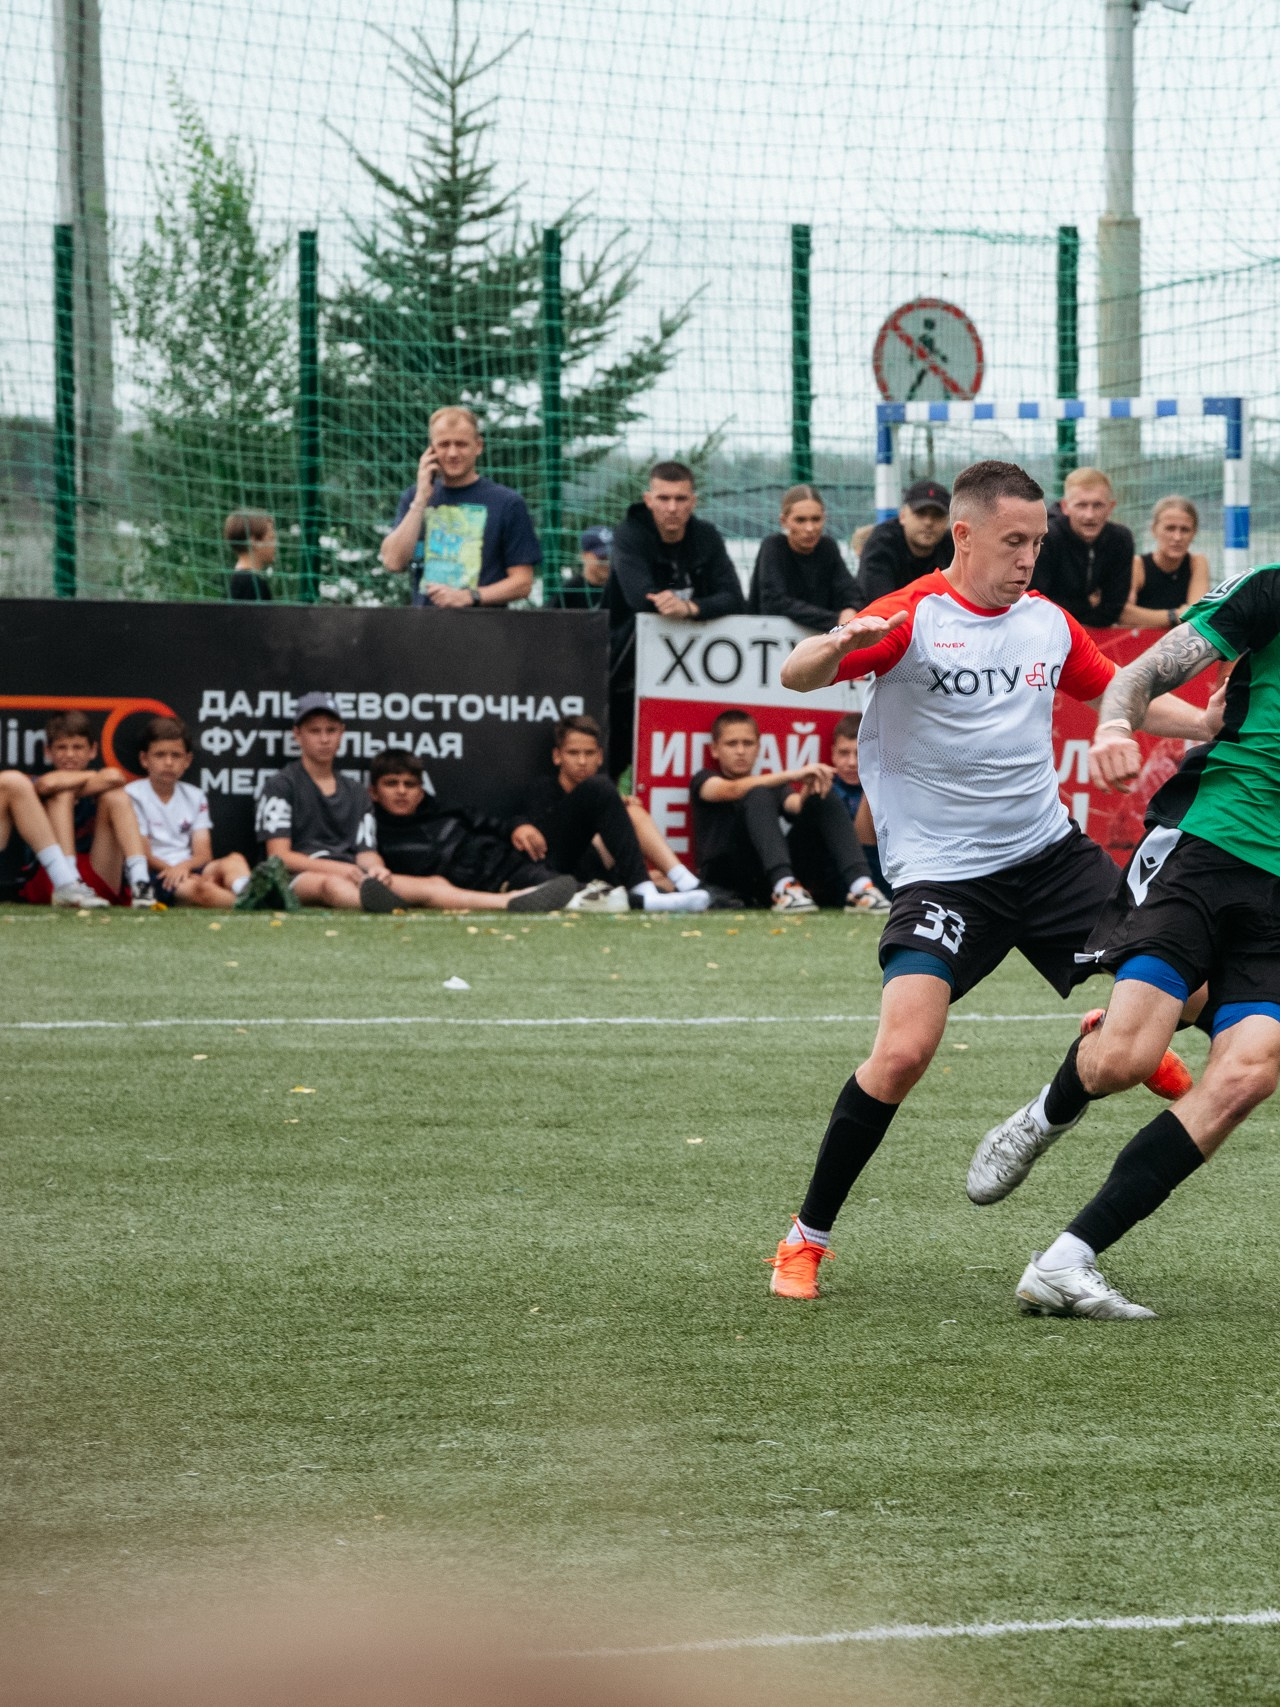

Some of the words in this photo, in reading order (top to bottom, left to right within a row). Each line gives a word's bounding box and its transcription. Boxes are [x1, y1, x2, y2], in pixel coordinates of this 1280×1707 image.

[656, 633, 803, 688] ХОТ
[927, 664, 1023, 697] ХОТУ
[198, 690, 585, 723] ДАЛЬЕВОСТОЧНАЯ
[200, 726, 464, 759] ФУТБЛЬНАЯ
[651, 721, 821, 778] ИГАЙ
[912, 900, 966, 955] 33
